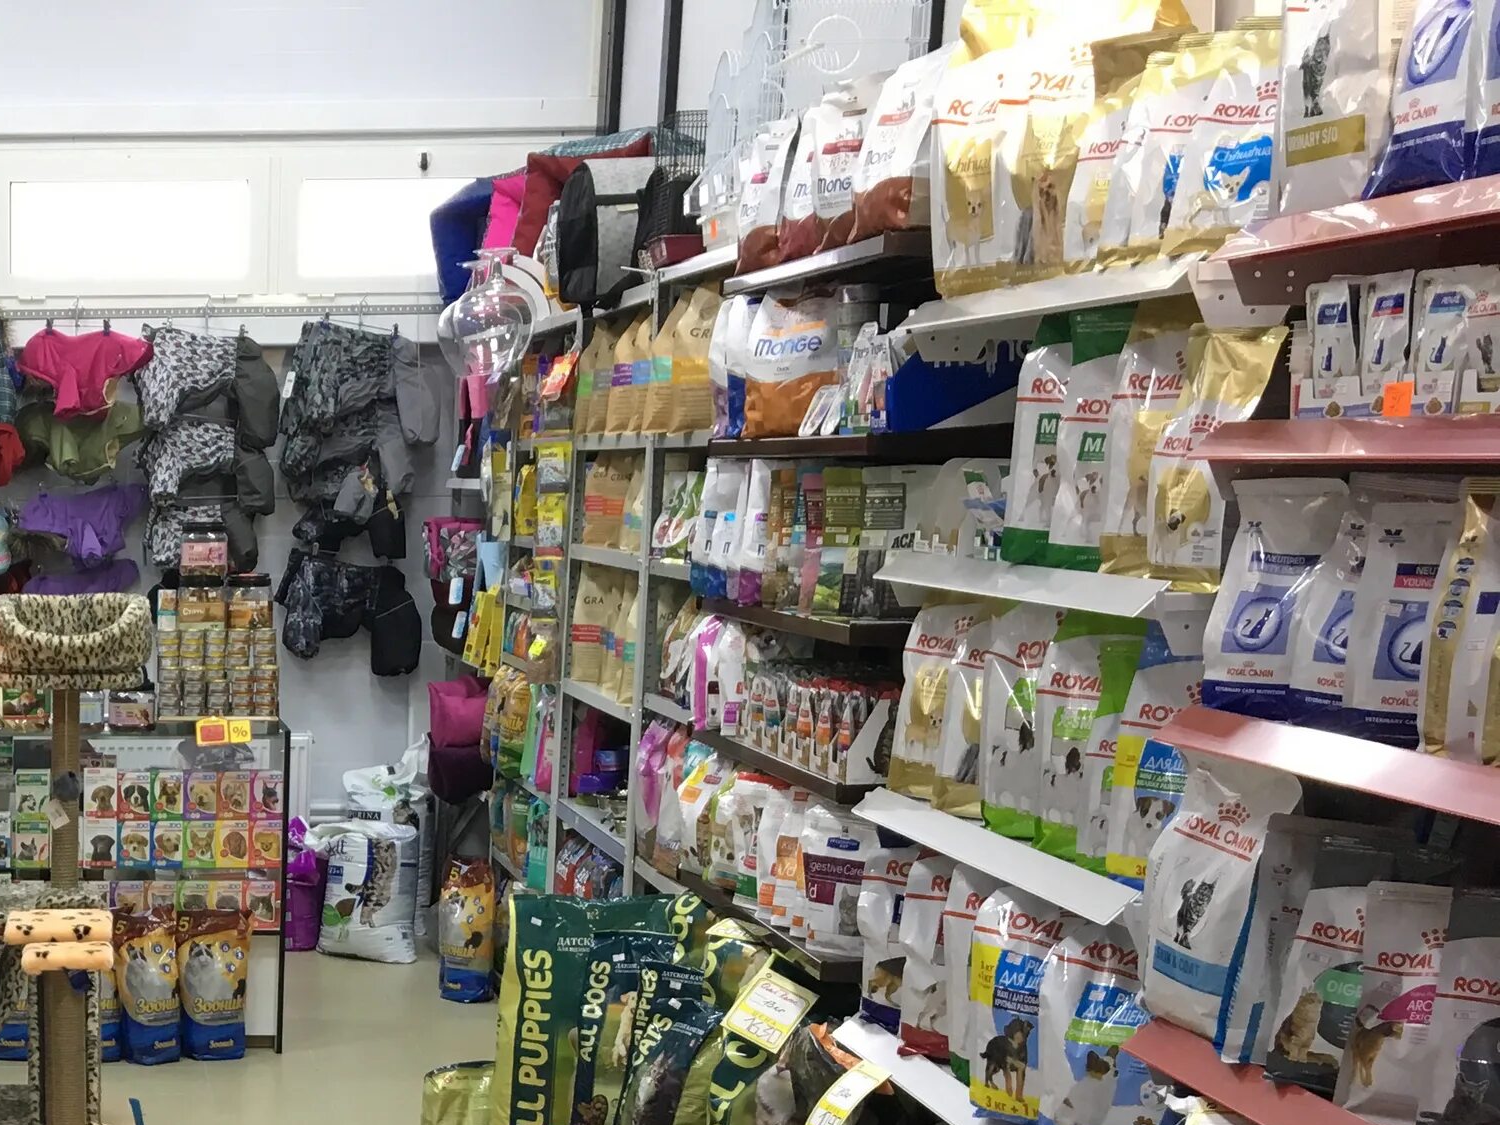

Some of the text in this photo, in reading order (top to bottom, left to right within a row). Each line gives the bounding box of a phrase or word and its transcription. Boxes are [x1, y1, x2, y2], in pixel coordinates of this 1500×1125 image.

[1378, 952, 1435, 969] ROYAL
[519, 949, 553, 1089] PUPPIES
[579, 1013, 599, 1063] ALL
